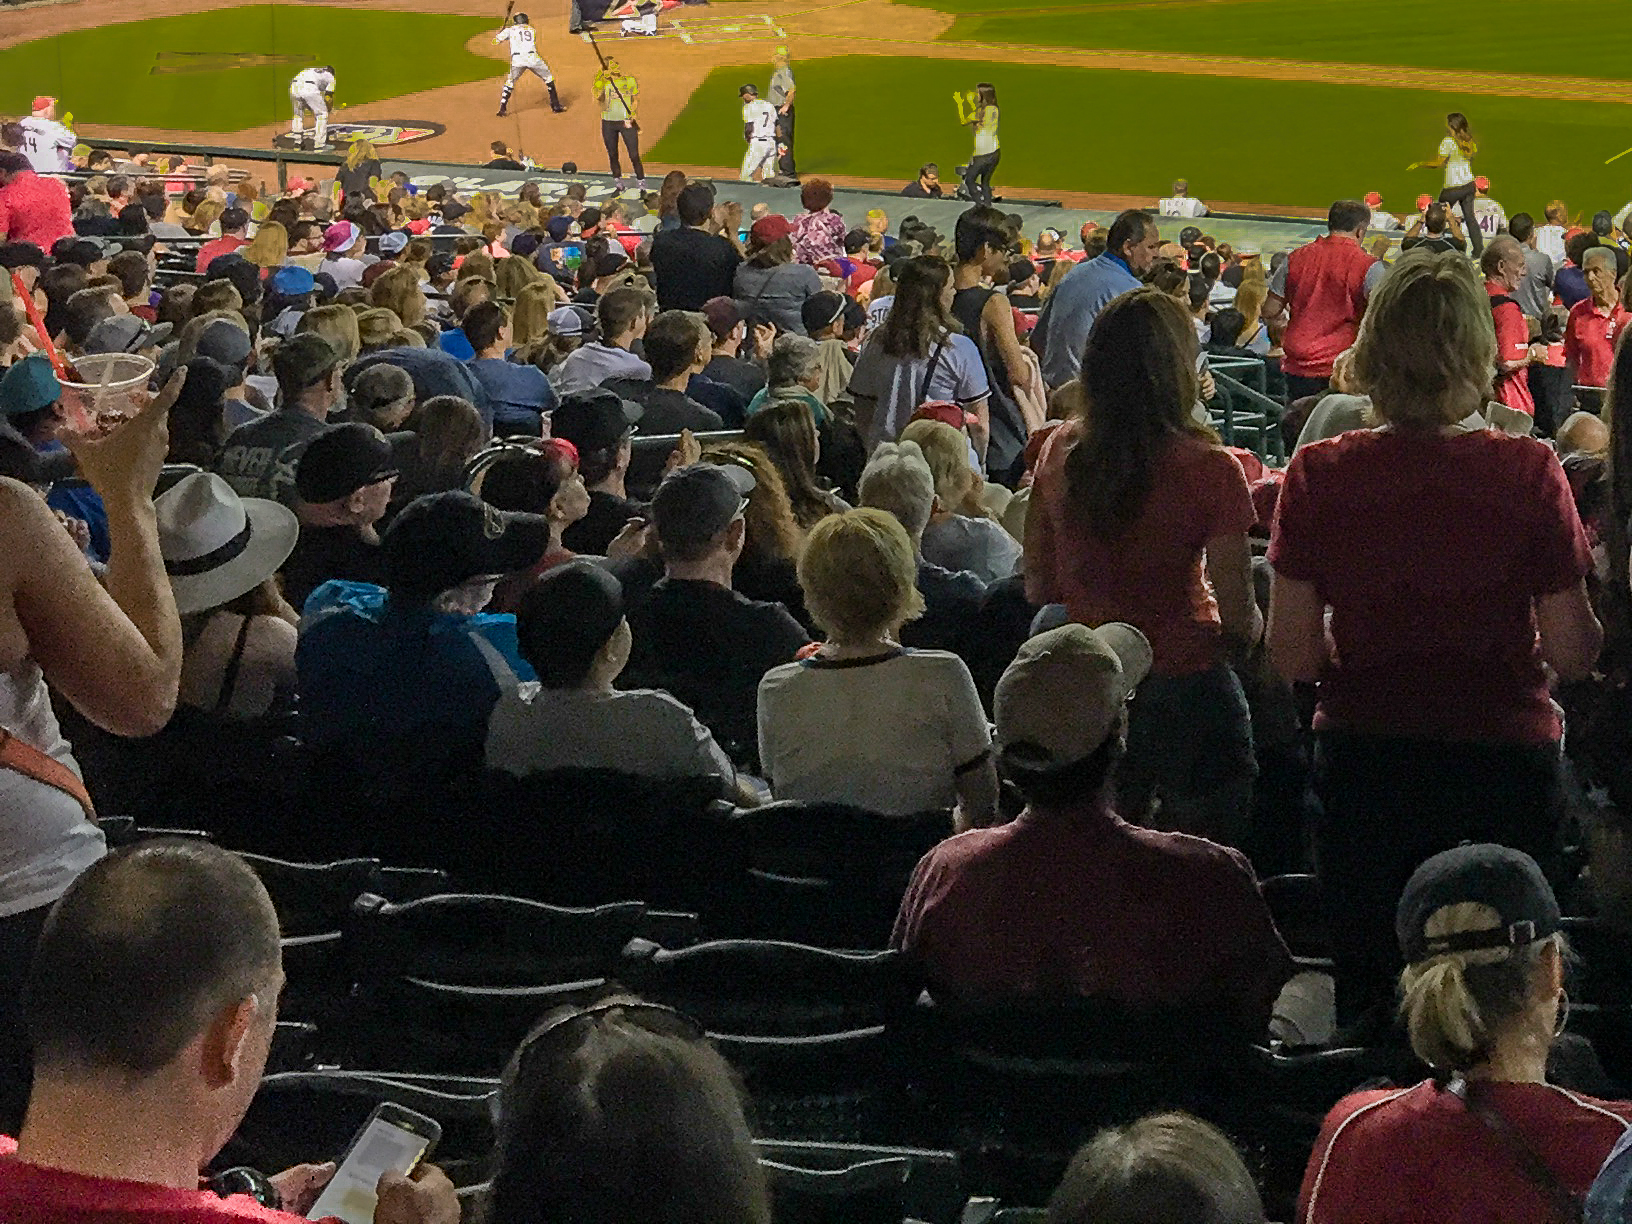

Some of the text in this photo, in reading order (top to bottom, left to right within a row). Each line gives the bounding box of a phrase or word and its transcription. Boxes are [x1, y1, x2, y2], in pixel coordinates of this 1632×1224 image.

[518, 30, 532, 43] 19
[762, 111, 769, 127] 7
[1480, 214, 1494, 233] 41
